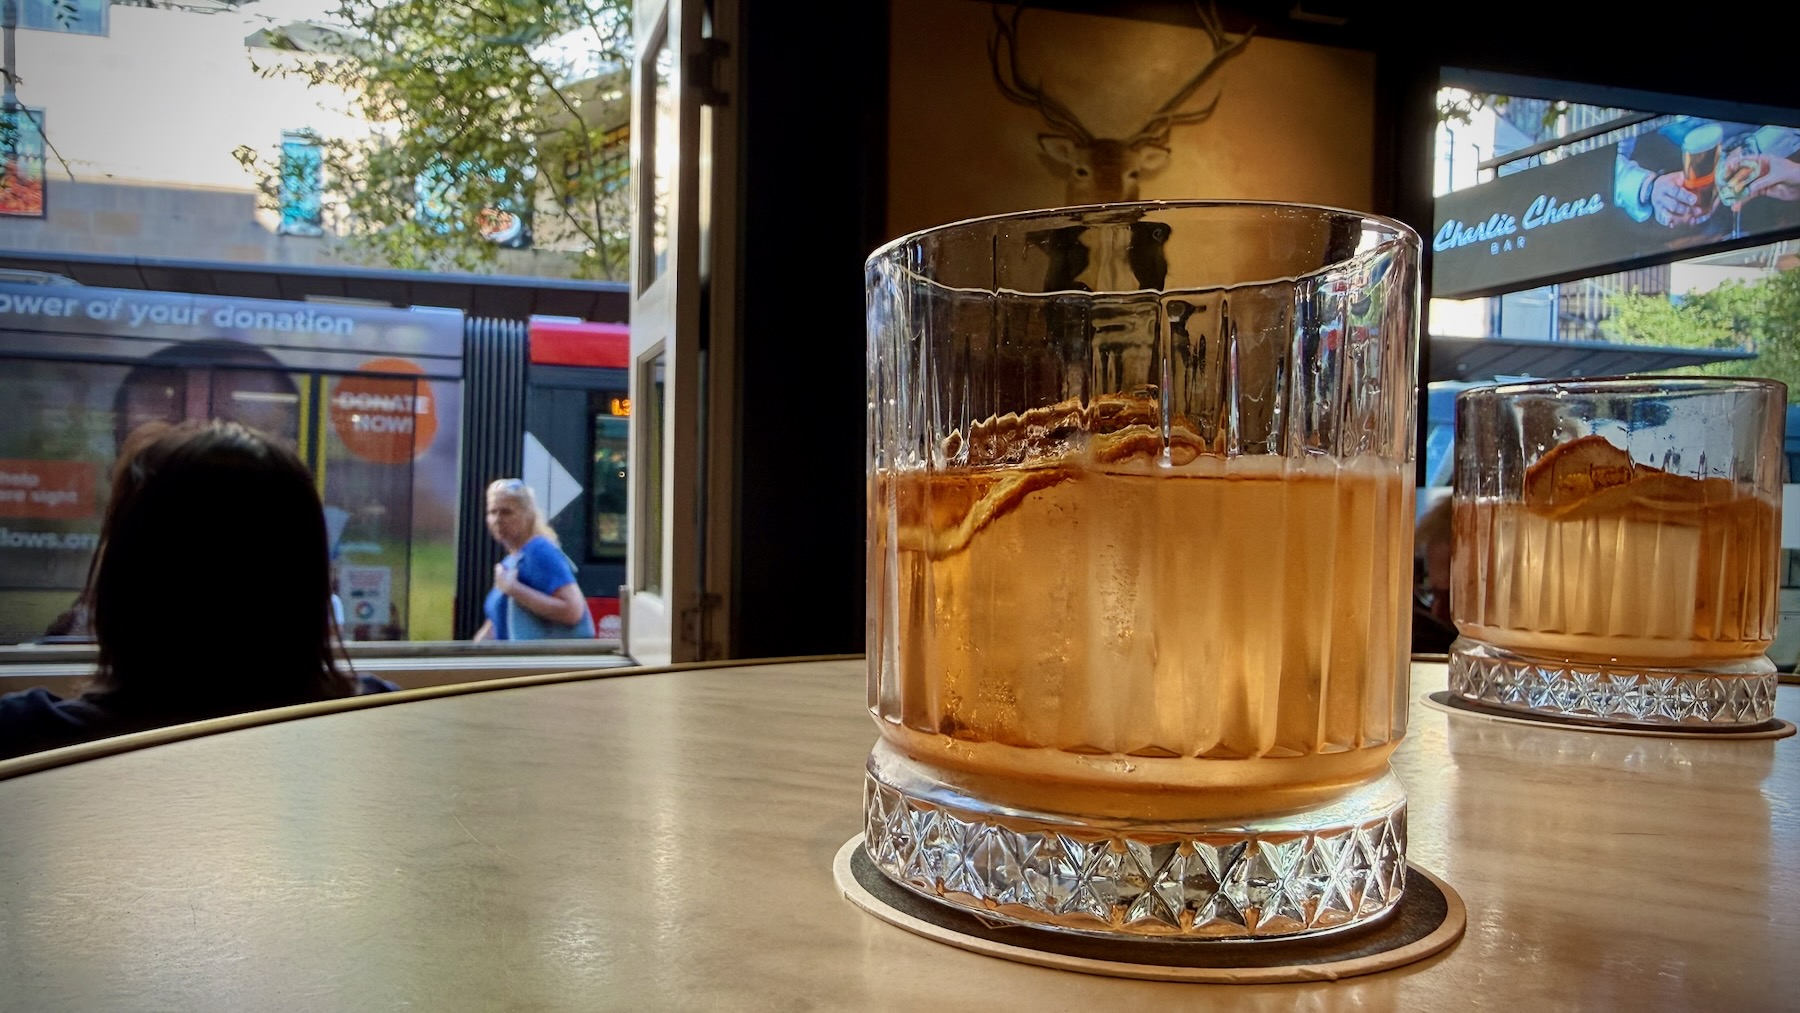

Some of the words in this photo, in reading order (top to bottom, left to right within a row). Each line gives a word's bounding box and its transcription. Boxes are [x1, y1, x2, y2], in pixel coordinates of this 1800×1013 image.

[1433, 213, 1517, 252] Charlie
[1521, 193, 1604, 230] Chans
[1490, 235, 1527, 255] BAR
[85, 297, 123, 320] of
[130, 303, 206, 327] your
[213, 305, 354, 335] donation
[339, 392, 429, 414] DONATE
